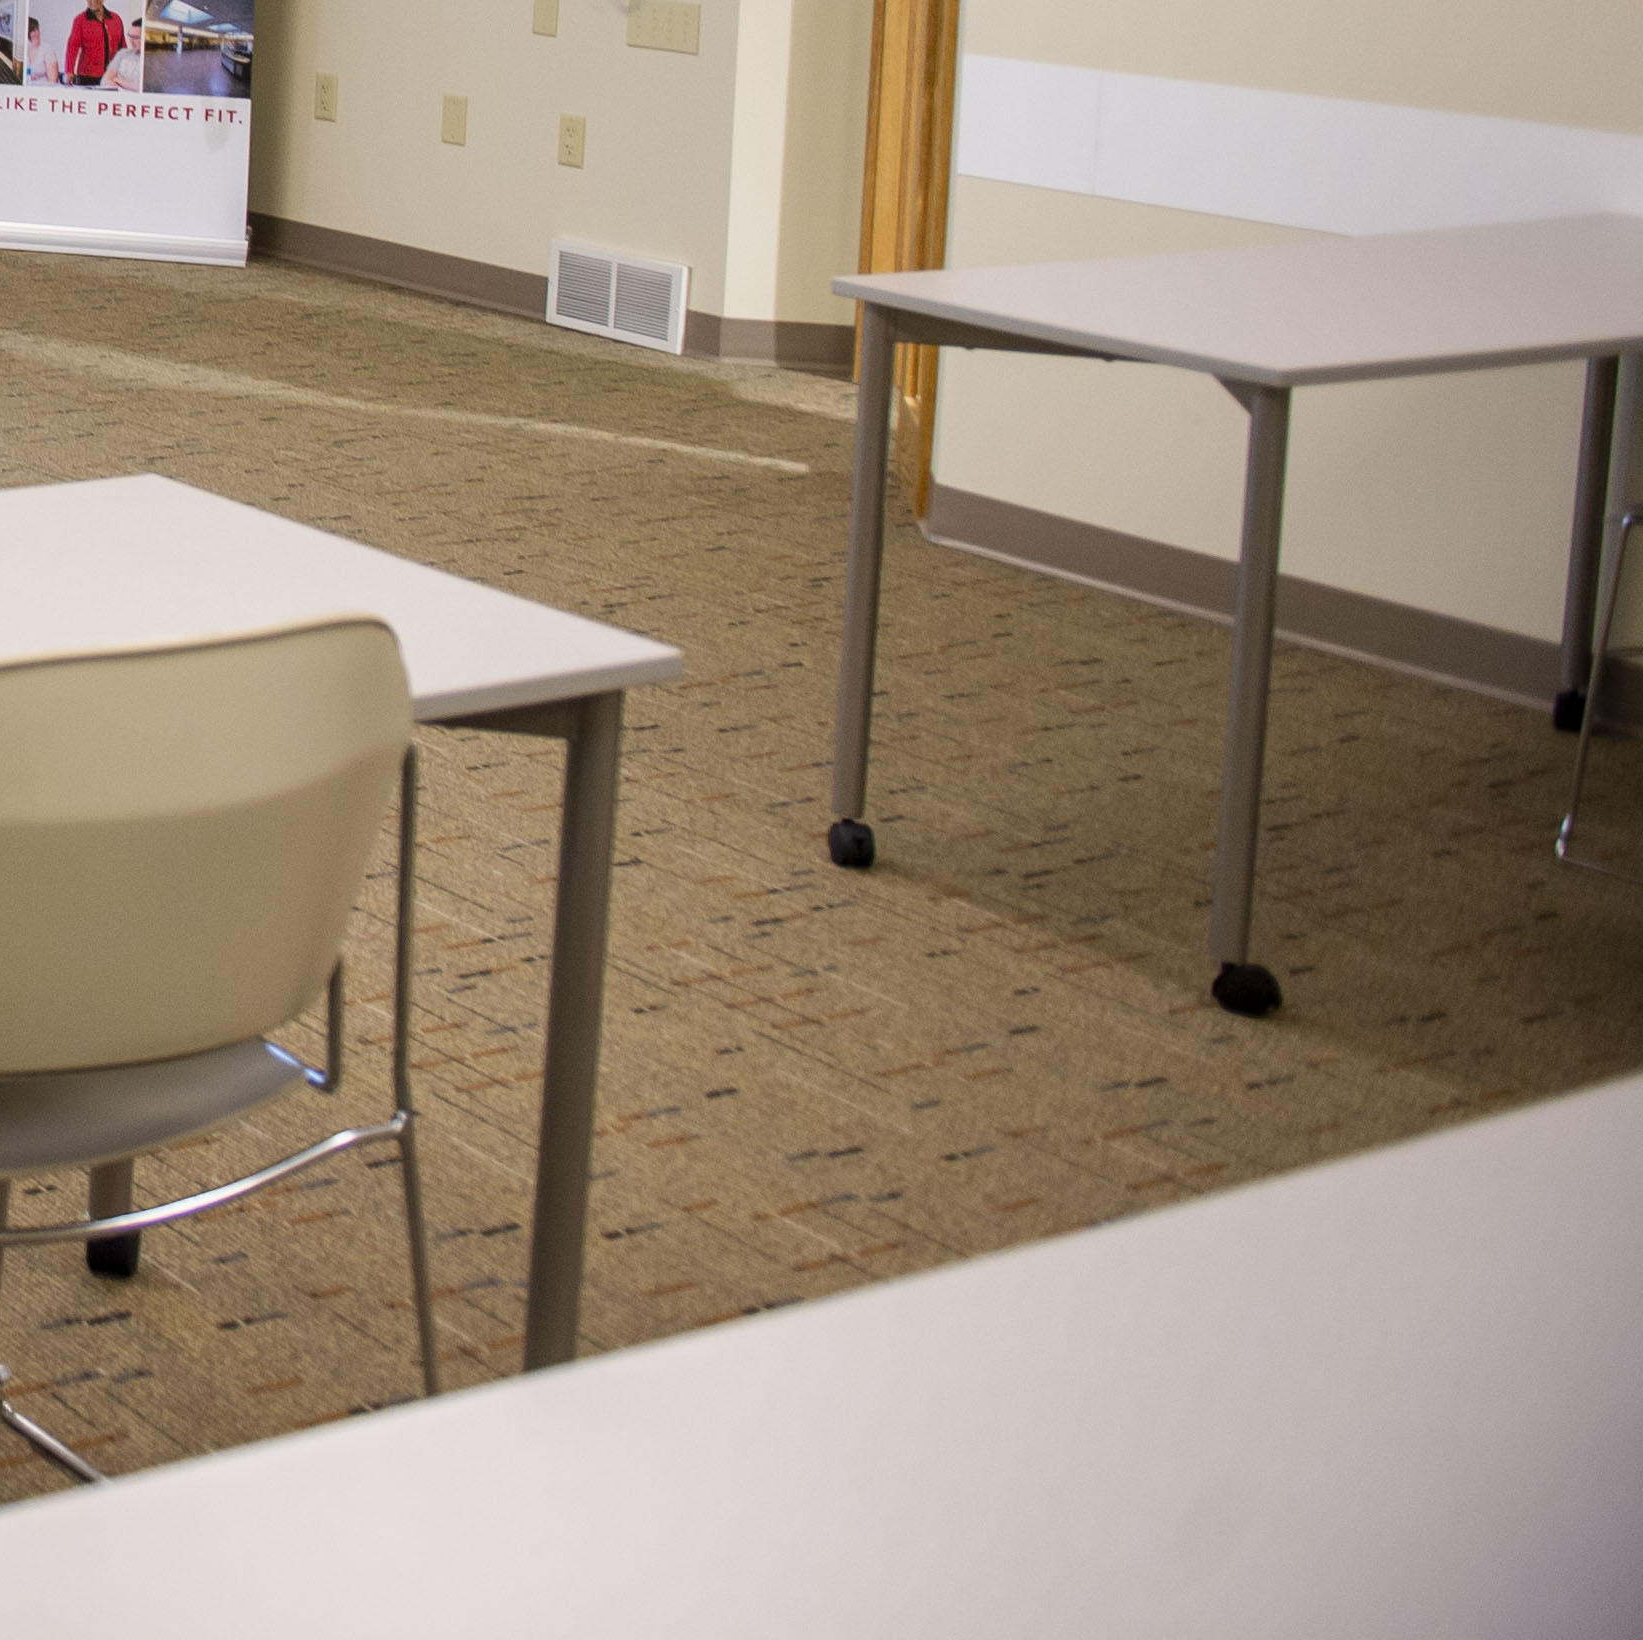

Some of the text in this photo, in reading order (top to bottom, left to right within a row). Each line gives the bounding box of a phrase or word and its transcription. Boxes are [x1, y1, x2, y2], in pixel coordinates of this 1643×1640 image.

[48, 99, 87, 115] THE
[98, 102, 193, 121] PERFECT
[204, 108, 243, 125] FIT.
